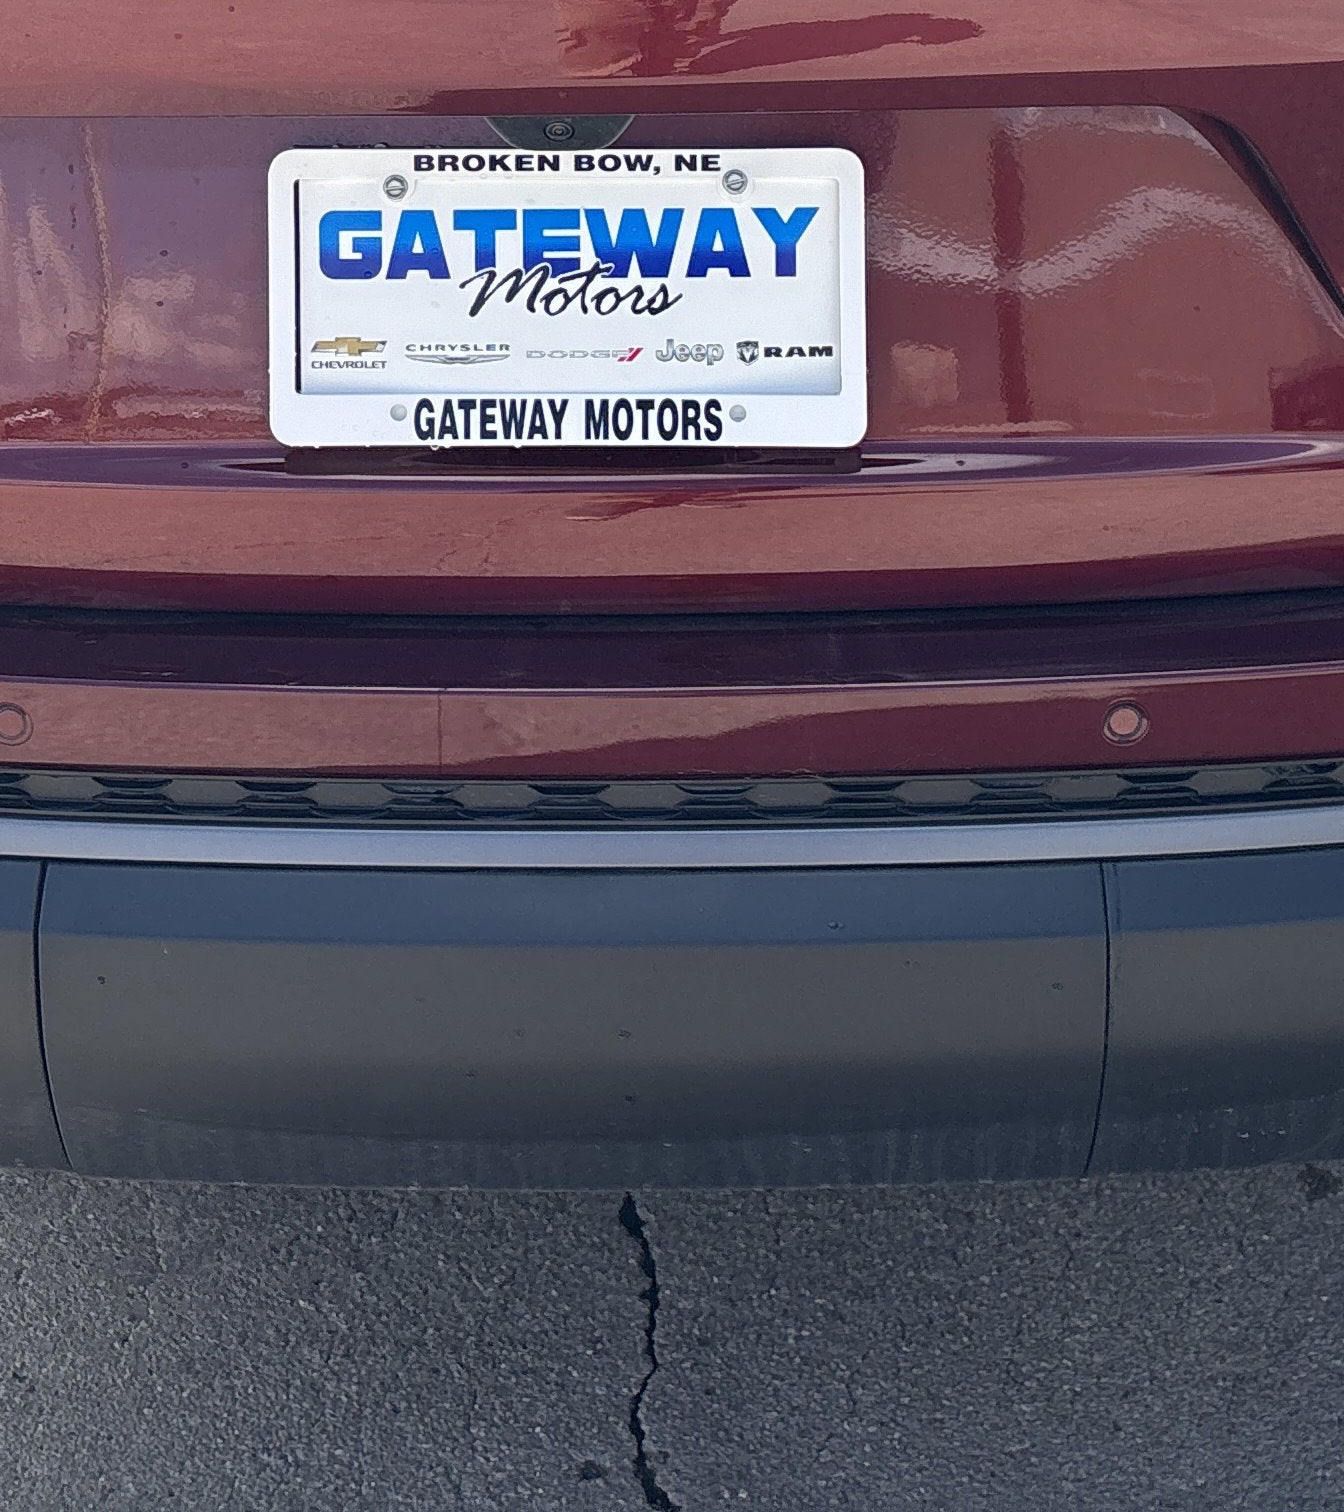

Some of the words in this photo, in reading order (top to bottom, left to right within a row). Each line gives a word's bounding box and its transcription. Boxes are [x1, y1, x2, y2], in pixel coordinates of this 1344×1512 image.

[413, 154, 560, 173] BROKEN
[573, 154, 662, 176] BOW,
[674, 153, 721, 172] NE
[318, 206, 821, 281] GATEWAY
[458, 260, 684, 318] Motors
[405, 343, 511, 352] CHRYSLER
[526, 349, 629, 359] DODGE
[655, 338, 725, 366] Jeep
[763, 345, 834, 358] RAM
[311, 360, 388, 370] CHEVROLET
[413, 398, 570, 442] GATEWAY
[584, 398, 724, 441] MOTORS
